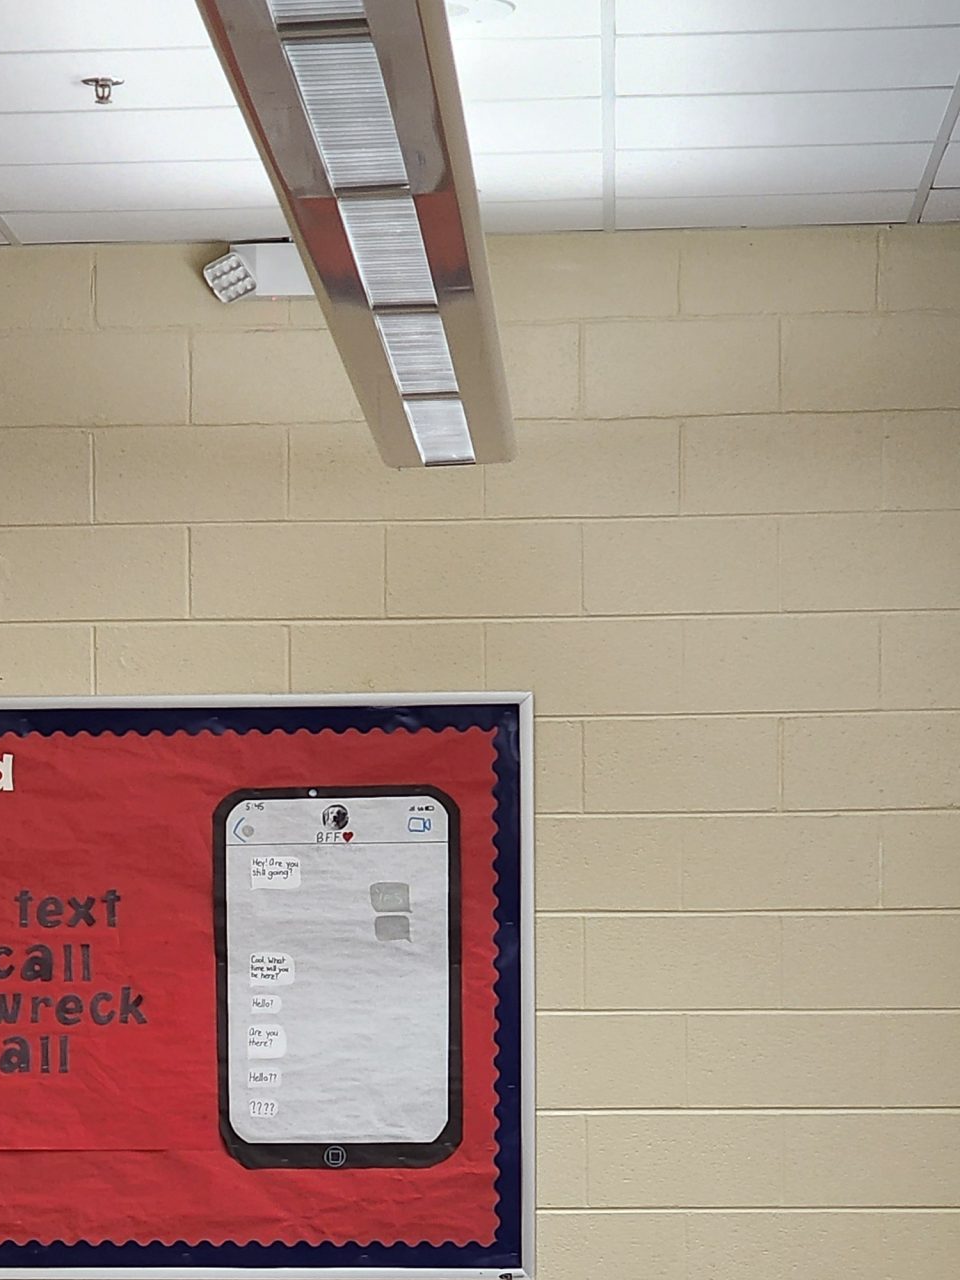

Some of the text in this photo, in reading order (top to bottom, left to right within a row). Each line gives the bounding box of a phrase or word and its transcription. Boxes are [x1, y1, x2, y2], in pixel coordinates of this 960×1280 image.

[316, 831, 342, 843] BFF
[252, 857, 299, 870] Hey! Are you
[252, 867, 293, 881] still going?
[14, 889, 121, 928] text
[266, 964, 277, 972] will
[260, 972, 280, 980] here?
[251, 998, 274, 1008] Hello?
[248, 1027, 279, 1039] Are you
[248, 1038, 273, 1048] there?
[248, 1071, 277, 1083] Hello??
[249, 1100, 275, 1116] ????
